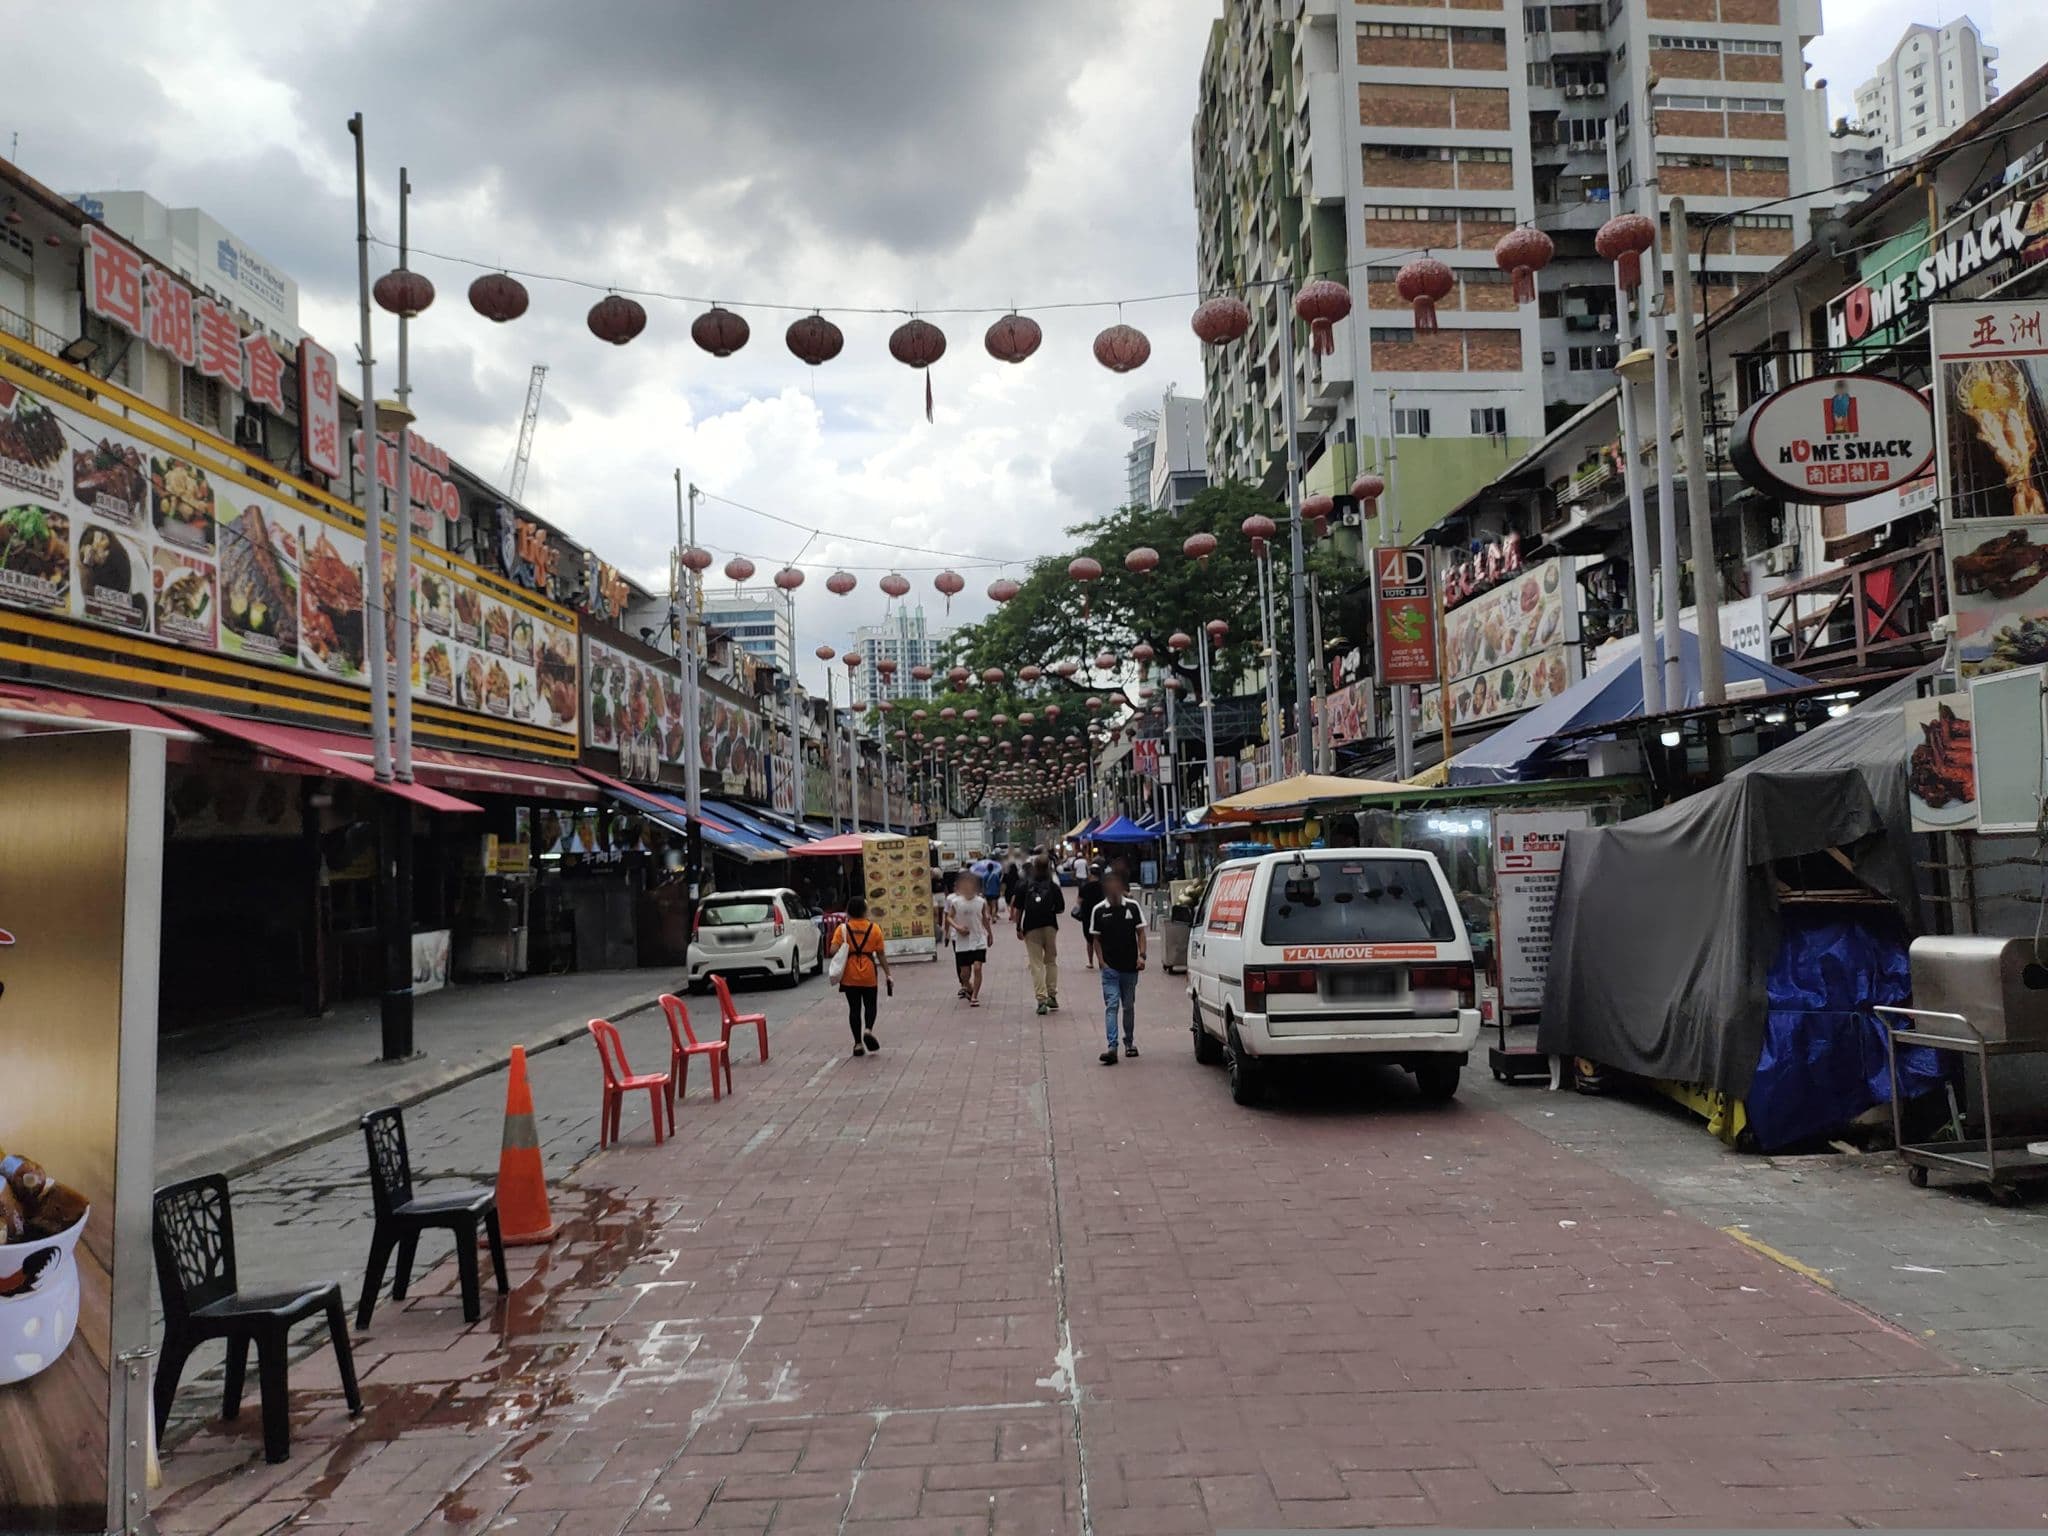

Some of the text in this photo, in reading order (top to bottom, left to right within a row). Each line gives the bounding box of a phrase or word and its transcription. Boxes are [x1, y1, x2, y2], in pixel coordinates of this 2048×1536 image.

[1829, 274, 1908, 348] HOME
[1917, 201, 2027, 299] SNACK
[89, 228, 285, 416] 西湖美食
[1970, 311, 2042, 348] 亚洲
[311, 355, 336, 467] 西湖
[1780, 440, 1912, 463] HOME SNACK
[1807, 463, 1888, 485] 南洋特产
[1382, 551, 1426, 585] 4D
[1385, 589, 1406, 597] TOTO
[1732, 624, 1760, 650] TOTO
[1135, 740, 1157, 756] KK
[1523, 832, 1551, 842] HOME
[1297, 947, 1374, 960] LALAMOVE
